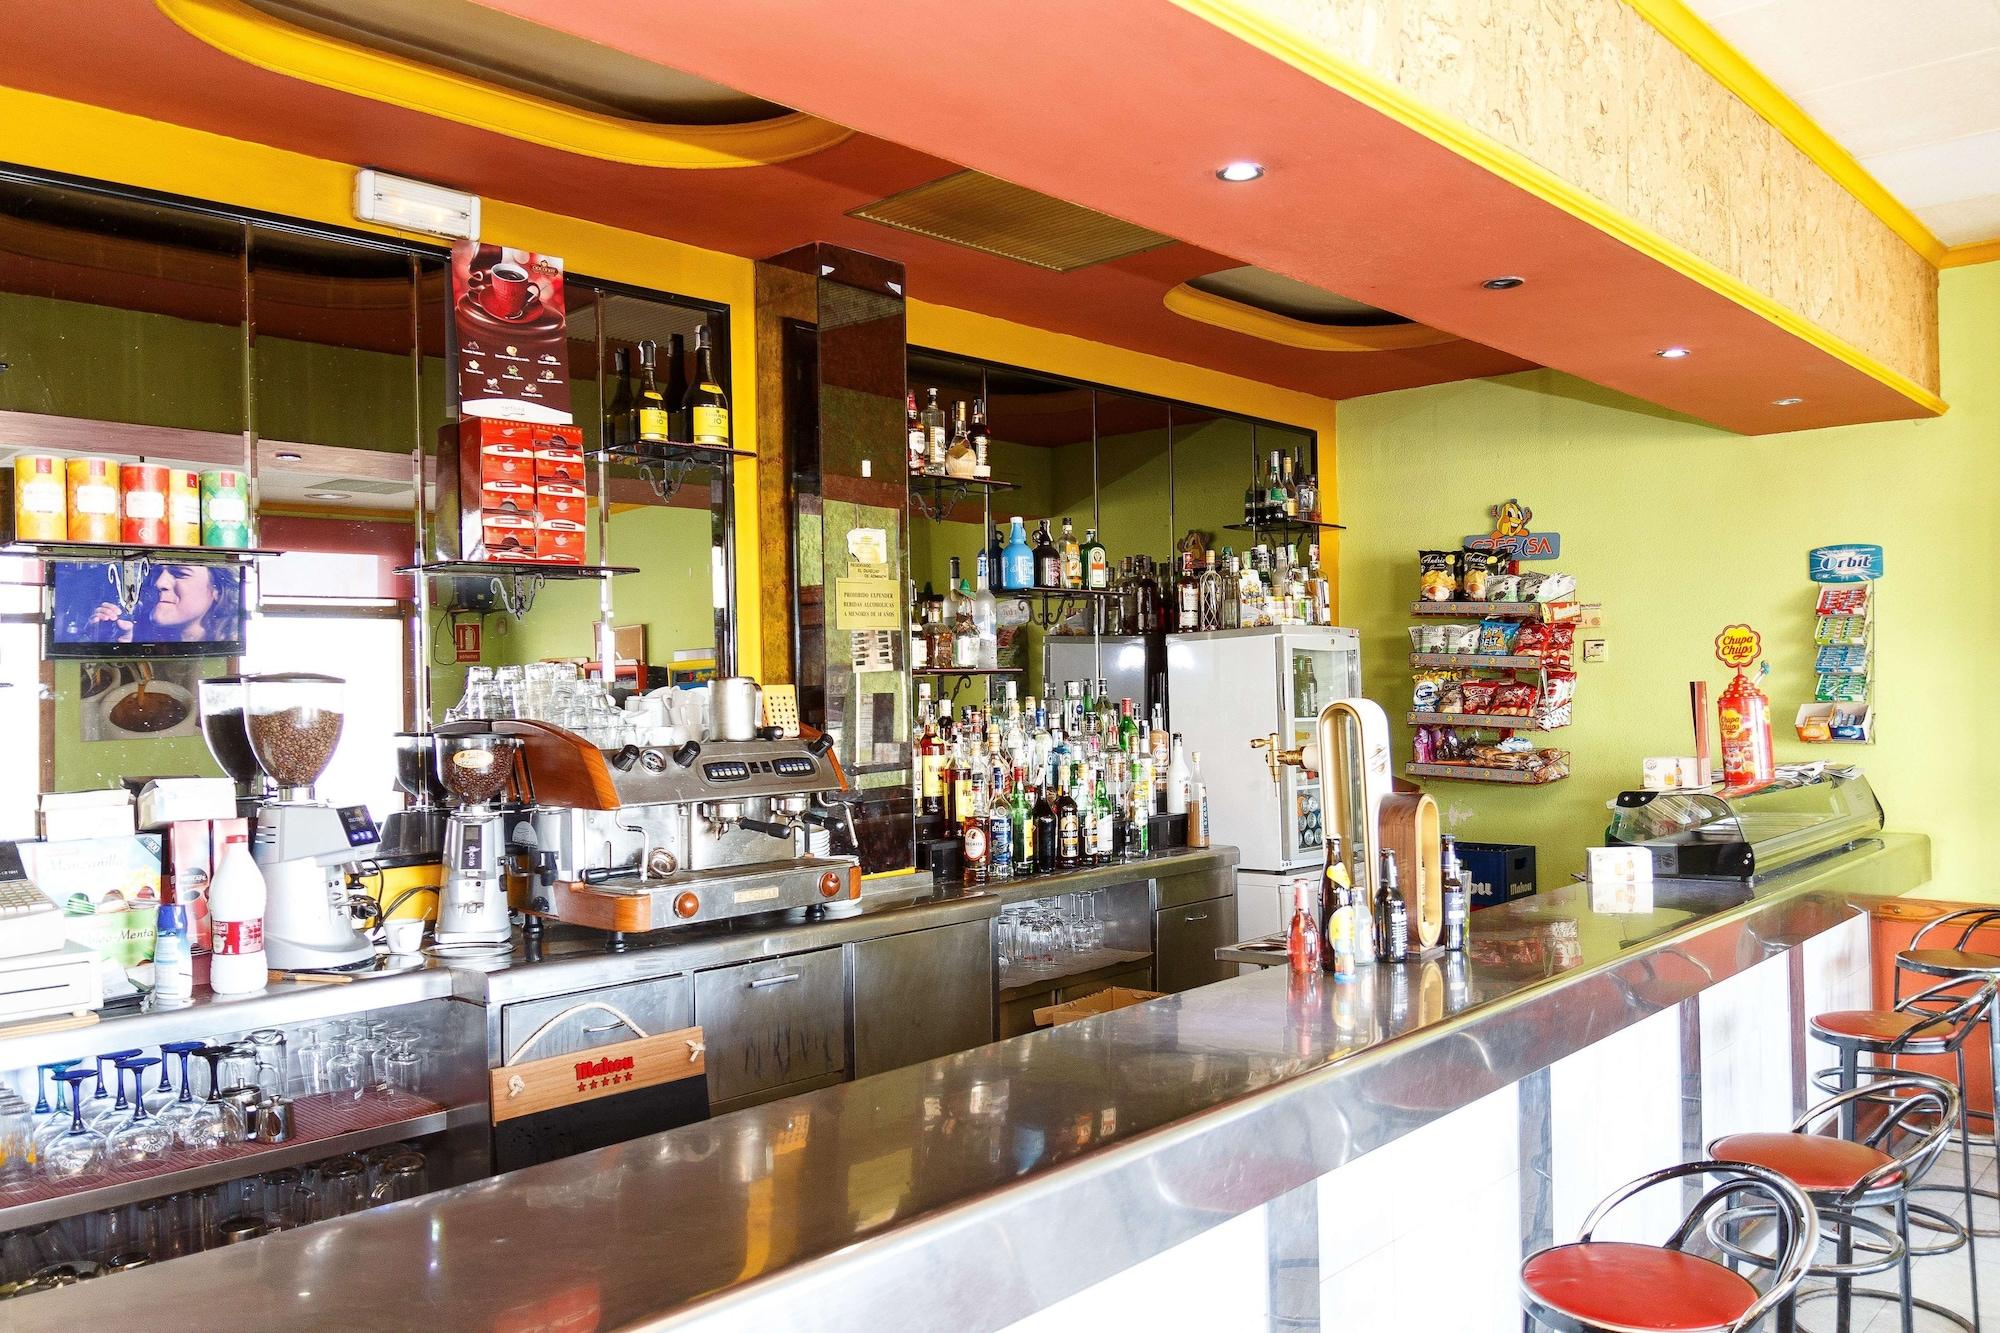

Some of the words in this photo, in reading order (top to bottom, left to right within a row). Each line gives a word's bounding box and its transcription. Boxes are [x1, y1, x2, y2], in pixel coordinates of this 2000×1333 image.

[1820, 555, 1873, 571] Orbit
[1723, 636, 1753, 646] Chupa
[1722, 646, 1753, 660] Chups
[1510, 881, 1532, 896] Mahou
[575, 1056, 635, 1081] Mahou
